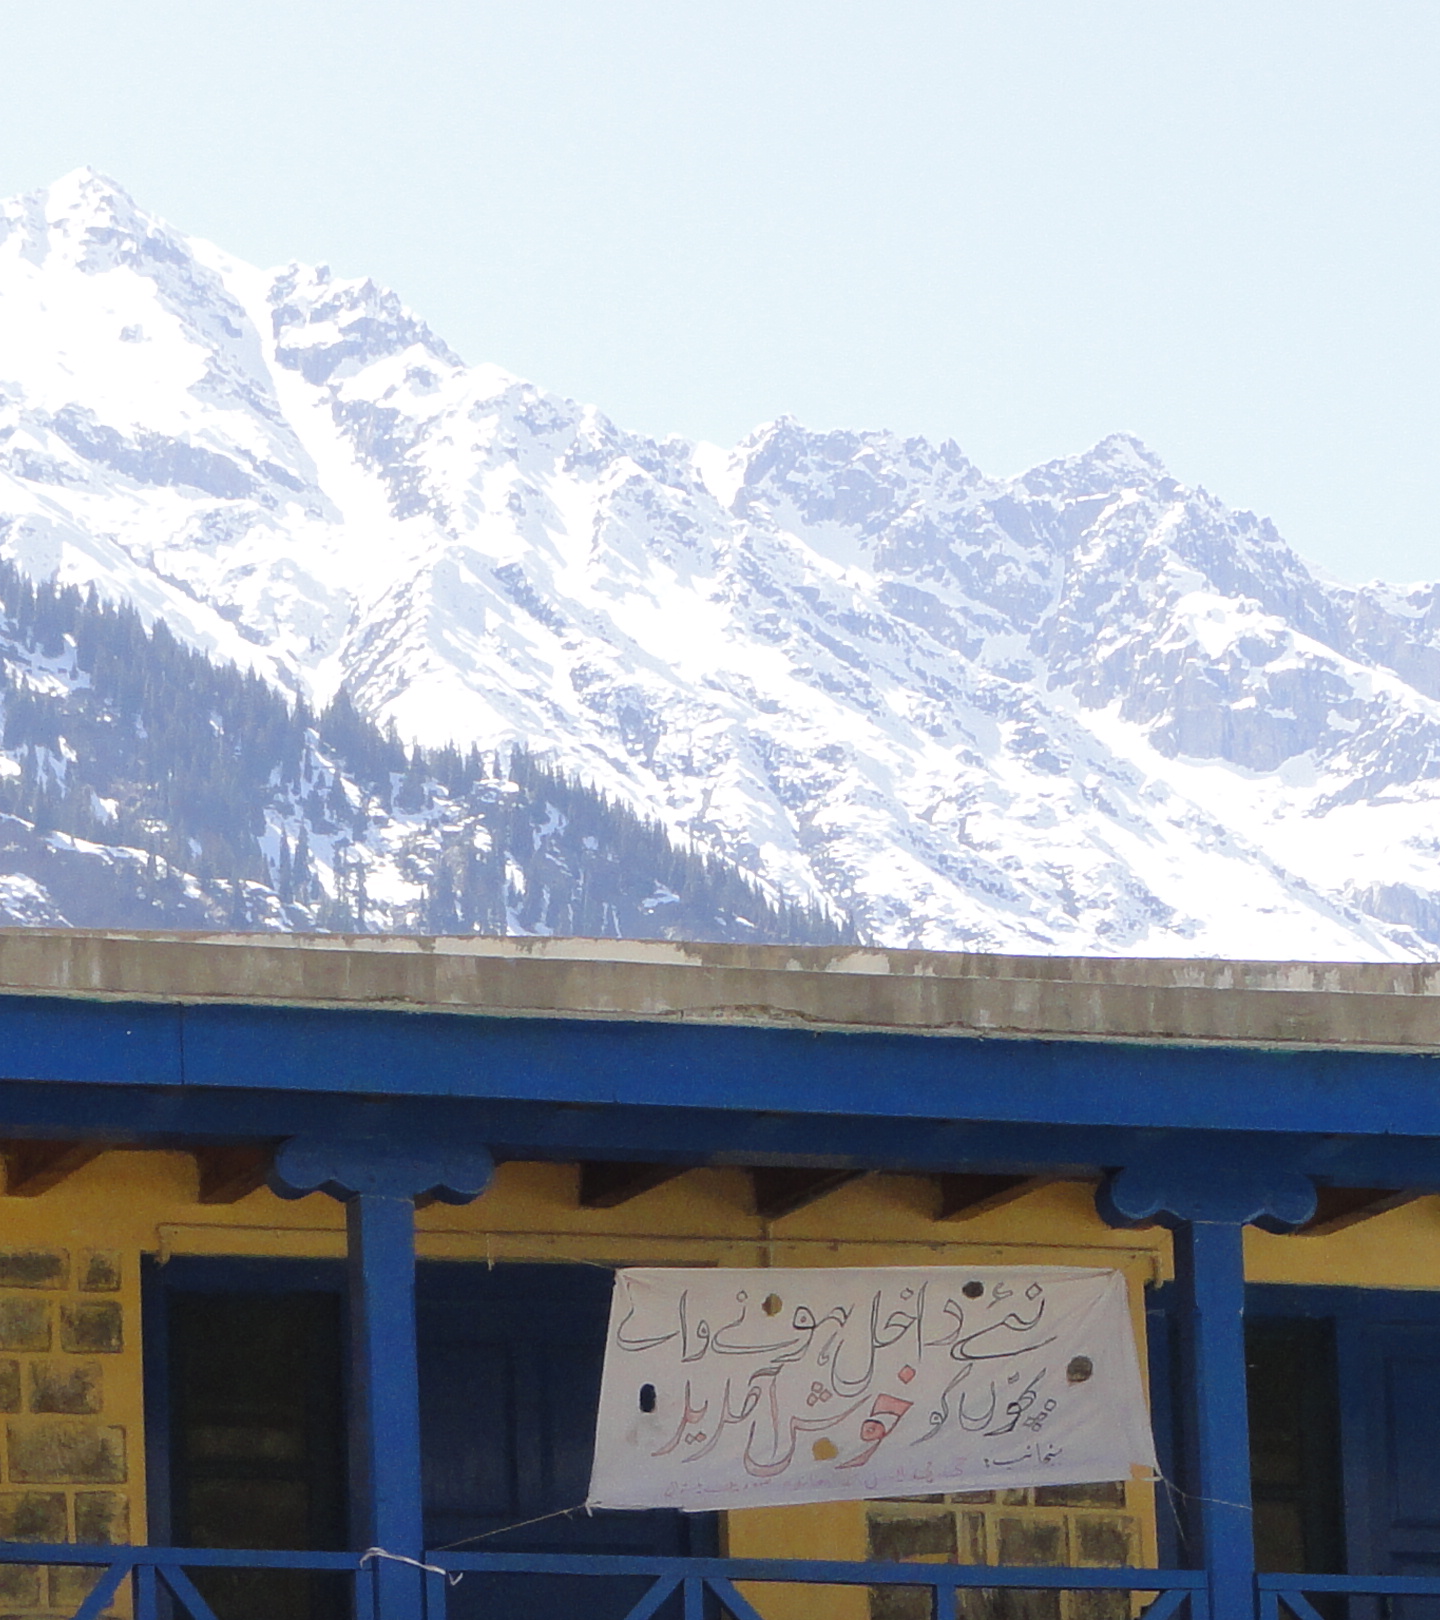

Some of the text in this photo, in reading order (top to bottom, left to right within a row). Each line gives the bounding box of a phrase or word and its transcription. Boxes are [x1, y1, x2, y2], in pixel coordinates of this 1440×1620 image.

[711, 1290, 856, 1366] ہونے
[831, 1280, 964, 1398] داخل
[742, 1364, 915, 1478] خوش
[910, 1362, 974, 1447] کو
